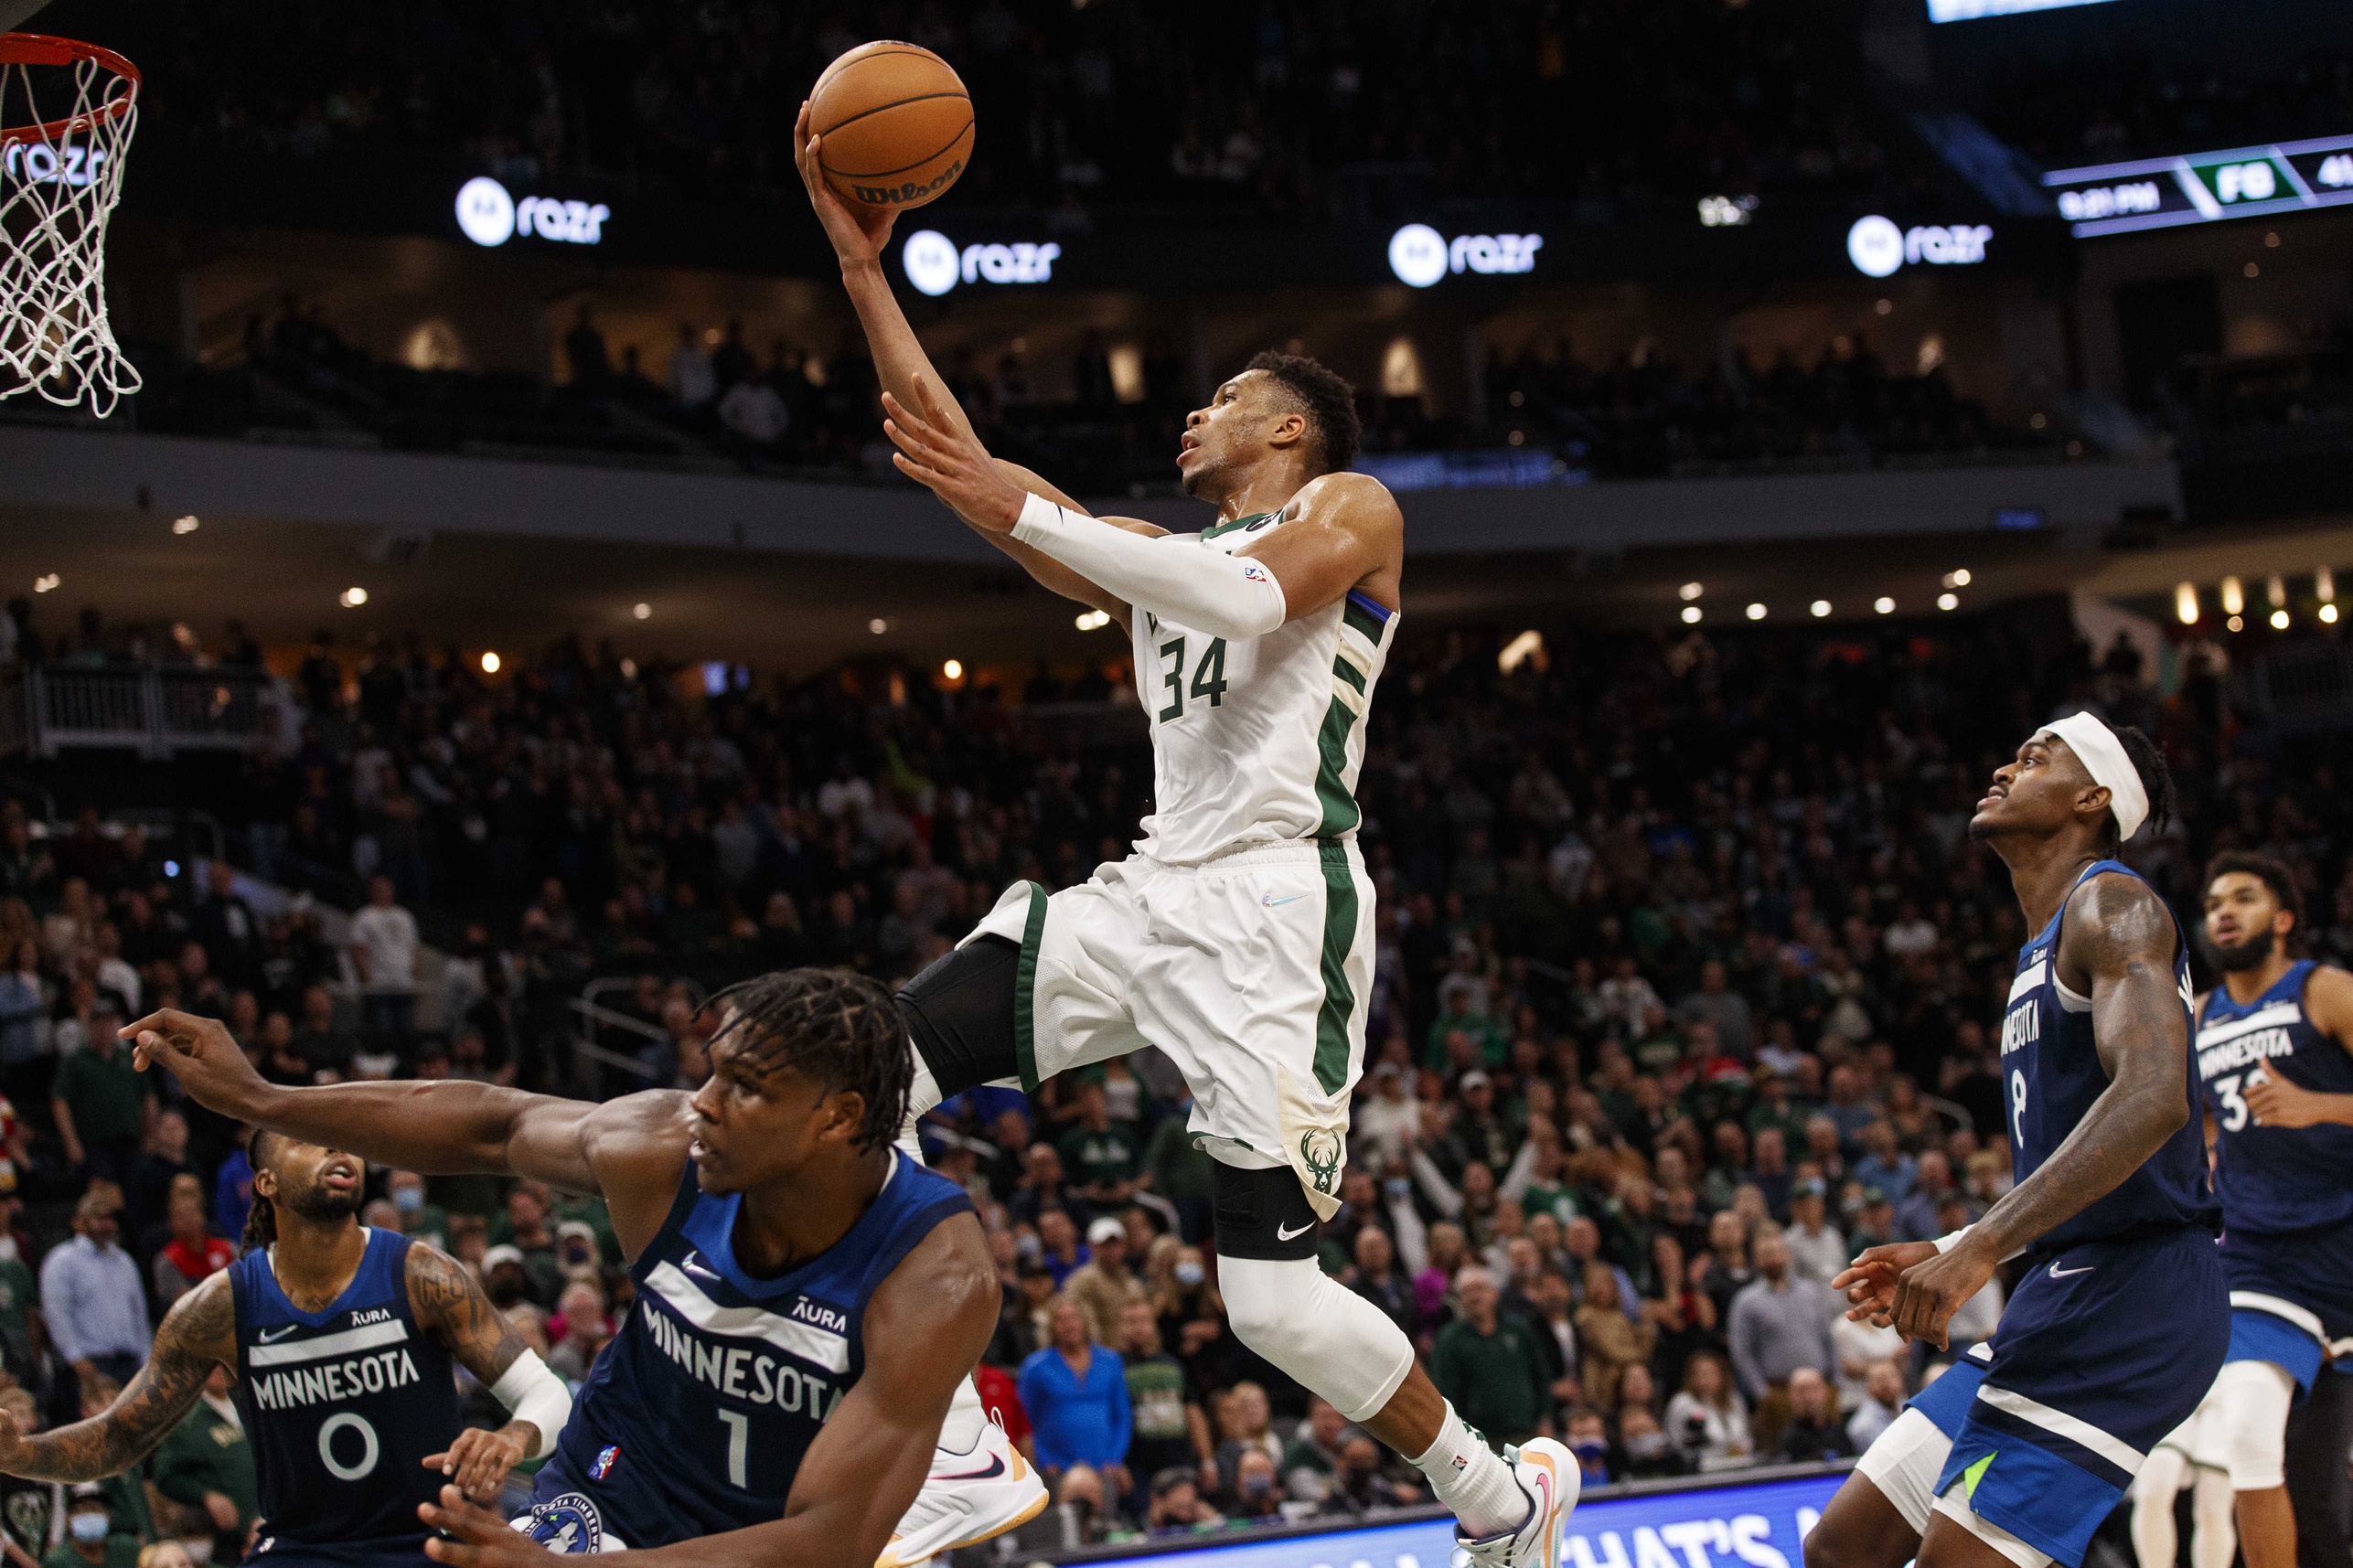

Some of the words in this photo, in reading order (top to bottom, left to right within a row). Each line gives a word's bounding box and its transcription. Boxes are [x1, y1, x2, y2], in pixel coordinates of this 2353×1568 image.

[5, 143, 108, 186] razr
[851, 160, 961, 204] Wilson
[517, 196, 611, 245] razr
[961, 243, 1062, 284] razr
[1159, 635, 1229, 725] 34
[250, 1348, 421, 1412] MINNESOTA
[317, 1412, 380, 1481] 0
[718, 1407, 748, 1489] 1
